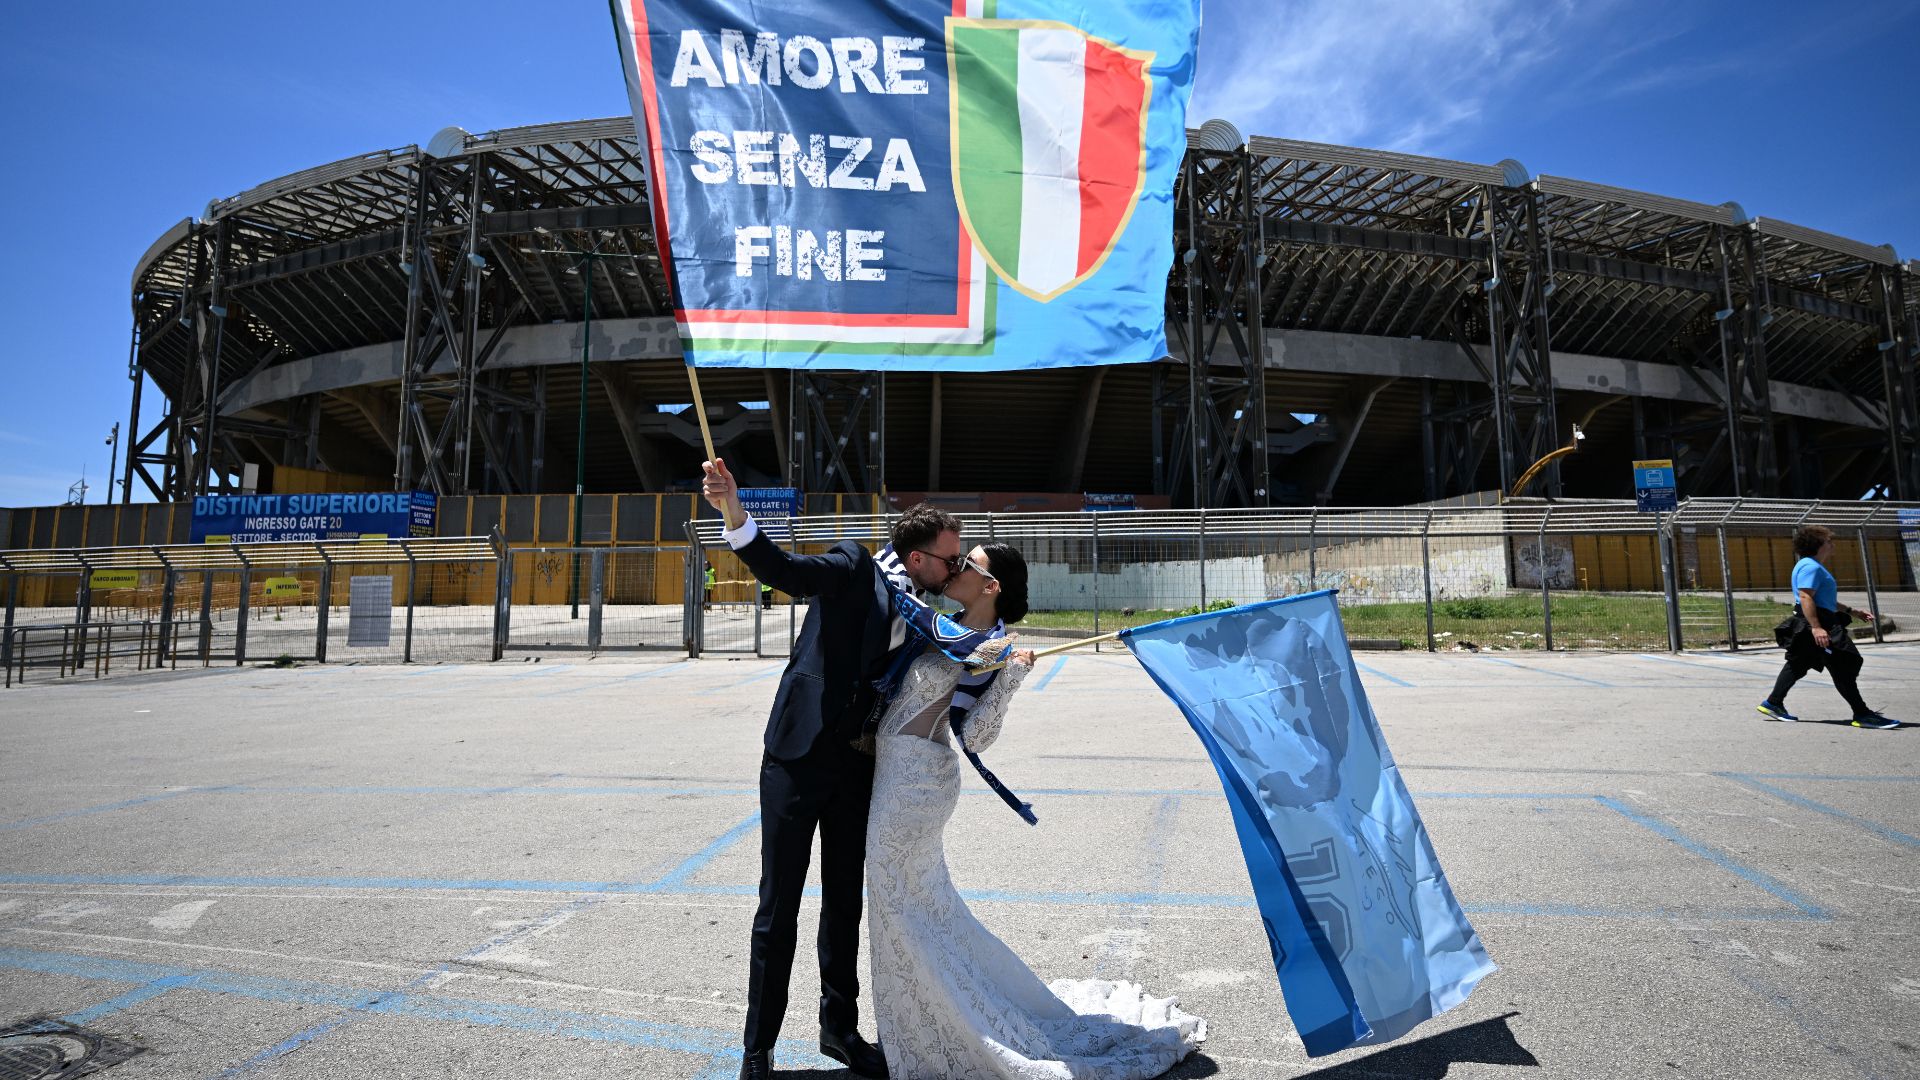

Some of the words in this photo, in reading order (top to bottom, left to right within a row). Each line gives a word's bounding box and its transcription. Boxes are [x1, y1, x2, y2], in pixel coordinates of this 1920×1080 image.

[670, 28, 929, 95] AMORE
[689, 130, 927, 193] SENZA
[735, 225, 887, 282] FINE
[737, 490, 753, 498] INTI
[755, 489, 795, 498] INFERIORE
[195, 496, 282, 516] DISTINTI
[288, 494, 410, 515] SUPERIORE
[741, 501, 760, 509] ESSO
[761, 501, 780, 509] GATE
[245, 517, 297, 530] INGRESSO
[299, 516, 327, 529] GATE
[329, 516, 342, 529] 20
[231, 533, 272, 543] SETTORE
[280, 532, 317, 542] SECTOR
